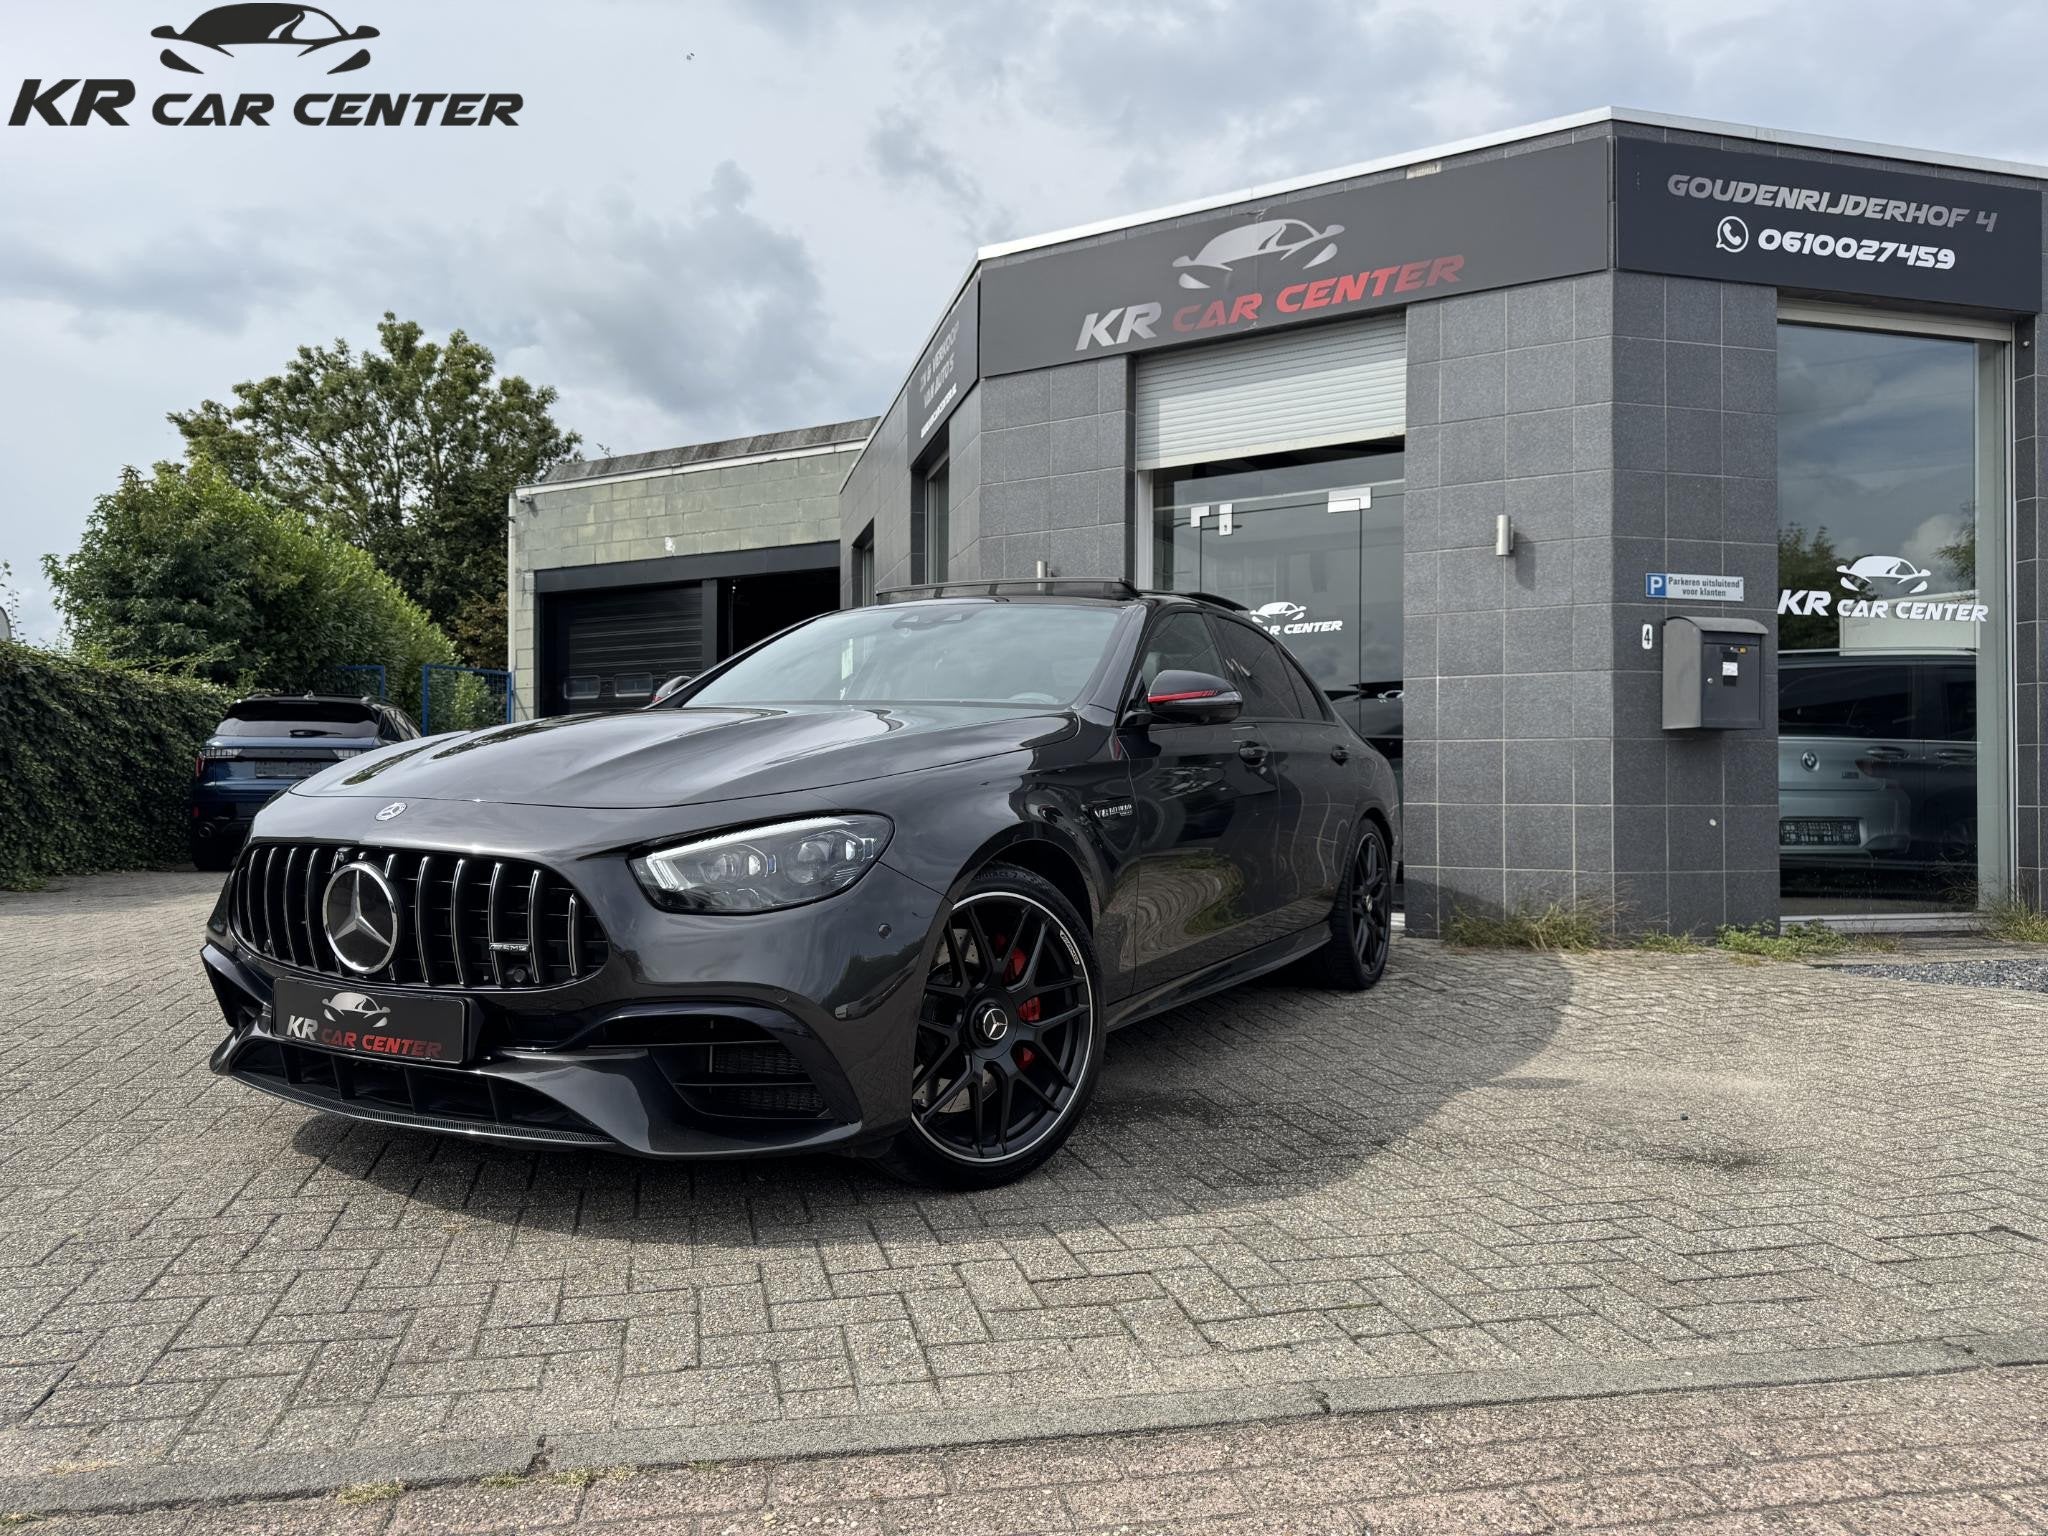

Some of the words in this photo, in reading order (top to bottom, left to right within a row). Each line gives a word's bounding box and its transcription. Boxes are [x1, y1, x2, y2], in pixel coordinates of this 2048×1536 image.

[1667, 173, 1970, 228] GOUDENRIJDERHOF
[1976, 210, 1998, 233] 4
[1758, 228, 1956, 270] 0610027459
[1075, 302, 1162, 351] KR
[1172, 292, 1262, 332] CAR
[1276, 254, 1465, 314] CENTER
[1650, 576, 1663, 594] P
[1668, 576, 1700, 586] Parkeren
[1702, 578, 1740, 588] uitsluitend
[1682, 588, 1698, 596] voor
[1700, 587, 1726, 597] klanten
[1777, 589, 1831, 616] KR
[1837, 600, 1889, 619] CAR
[1895, 602, 1989, 622] CENTER
[1283, 620, 1343, 635] CENTER
[1643, 627, 1651, 645] 4
[286, 1015, 318, 1041] KR
[321, 1028, 357, 1048] CAR
[361, 1035, 442, 1057] CENTER
